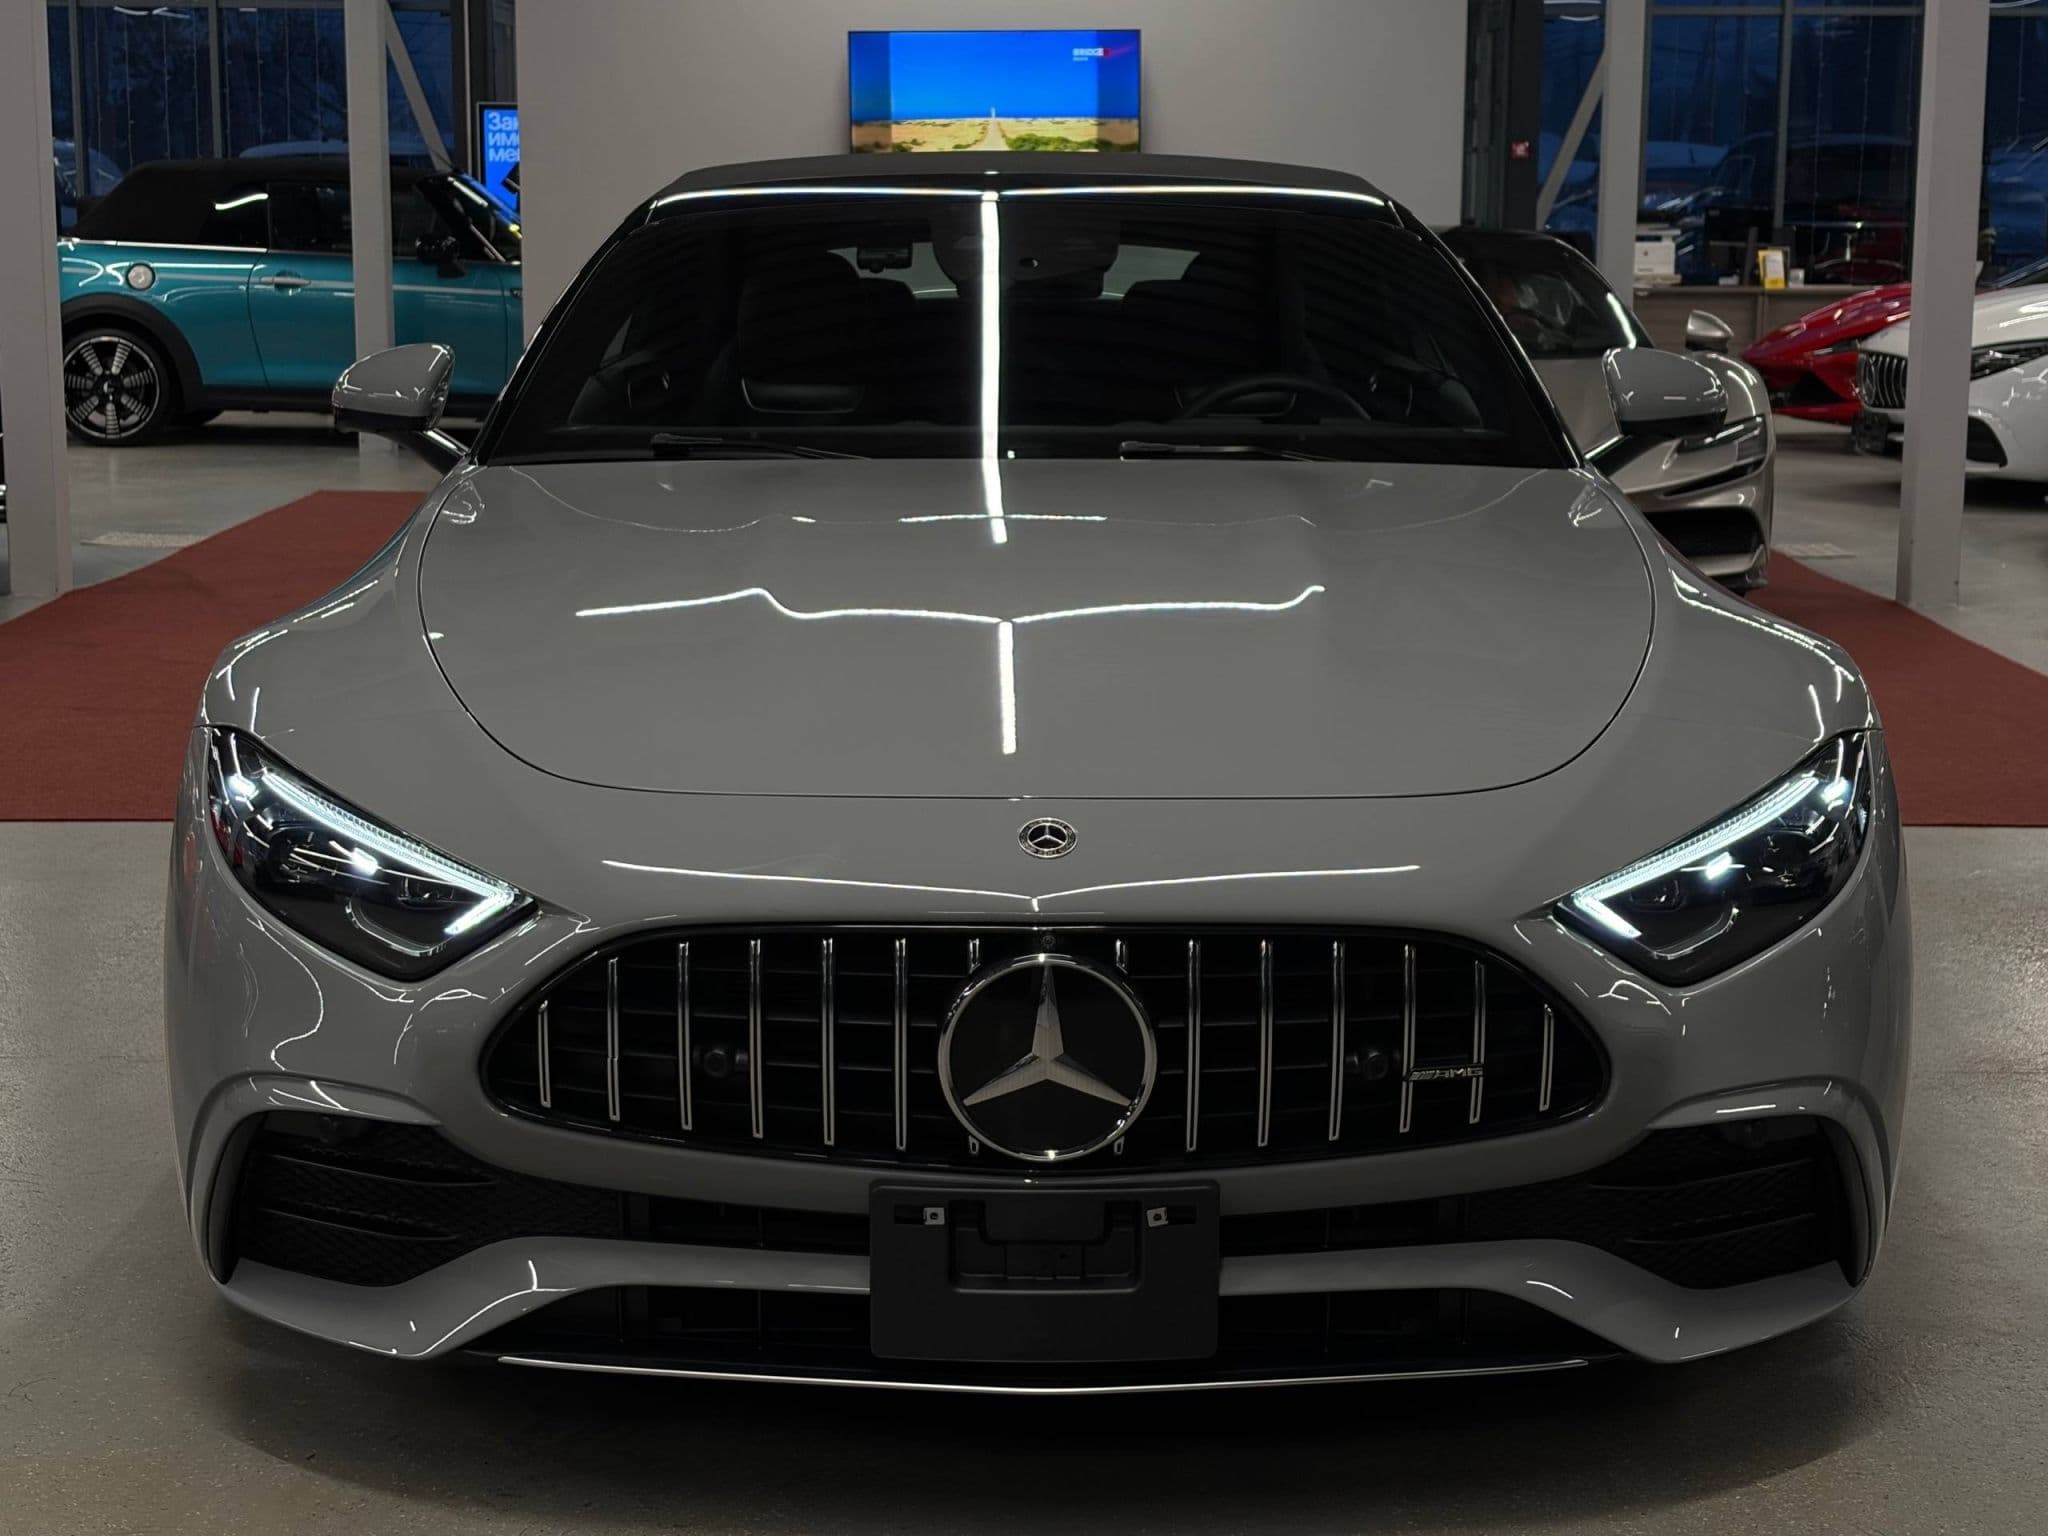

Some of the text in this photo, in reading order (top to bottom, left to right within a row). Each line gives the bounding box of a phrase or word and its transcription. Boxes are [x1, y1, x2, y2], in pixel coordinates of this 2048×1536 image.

[488, 132, 520, 146] им
[488, 148, 520, 162] ме
[1431, 1067, 1483, 1079] AMG
